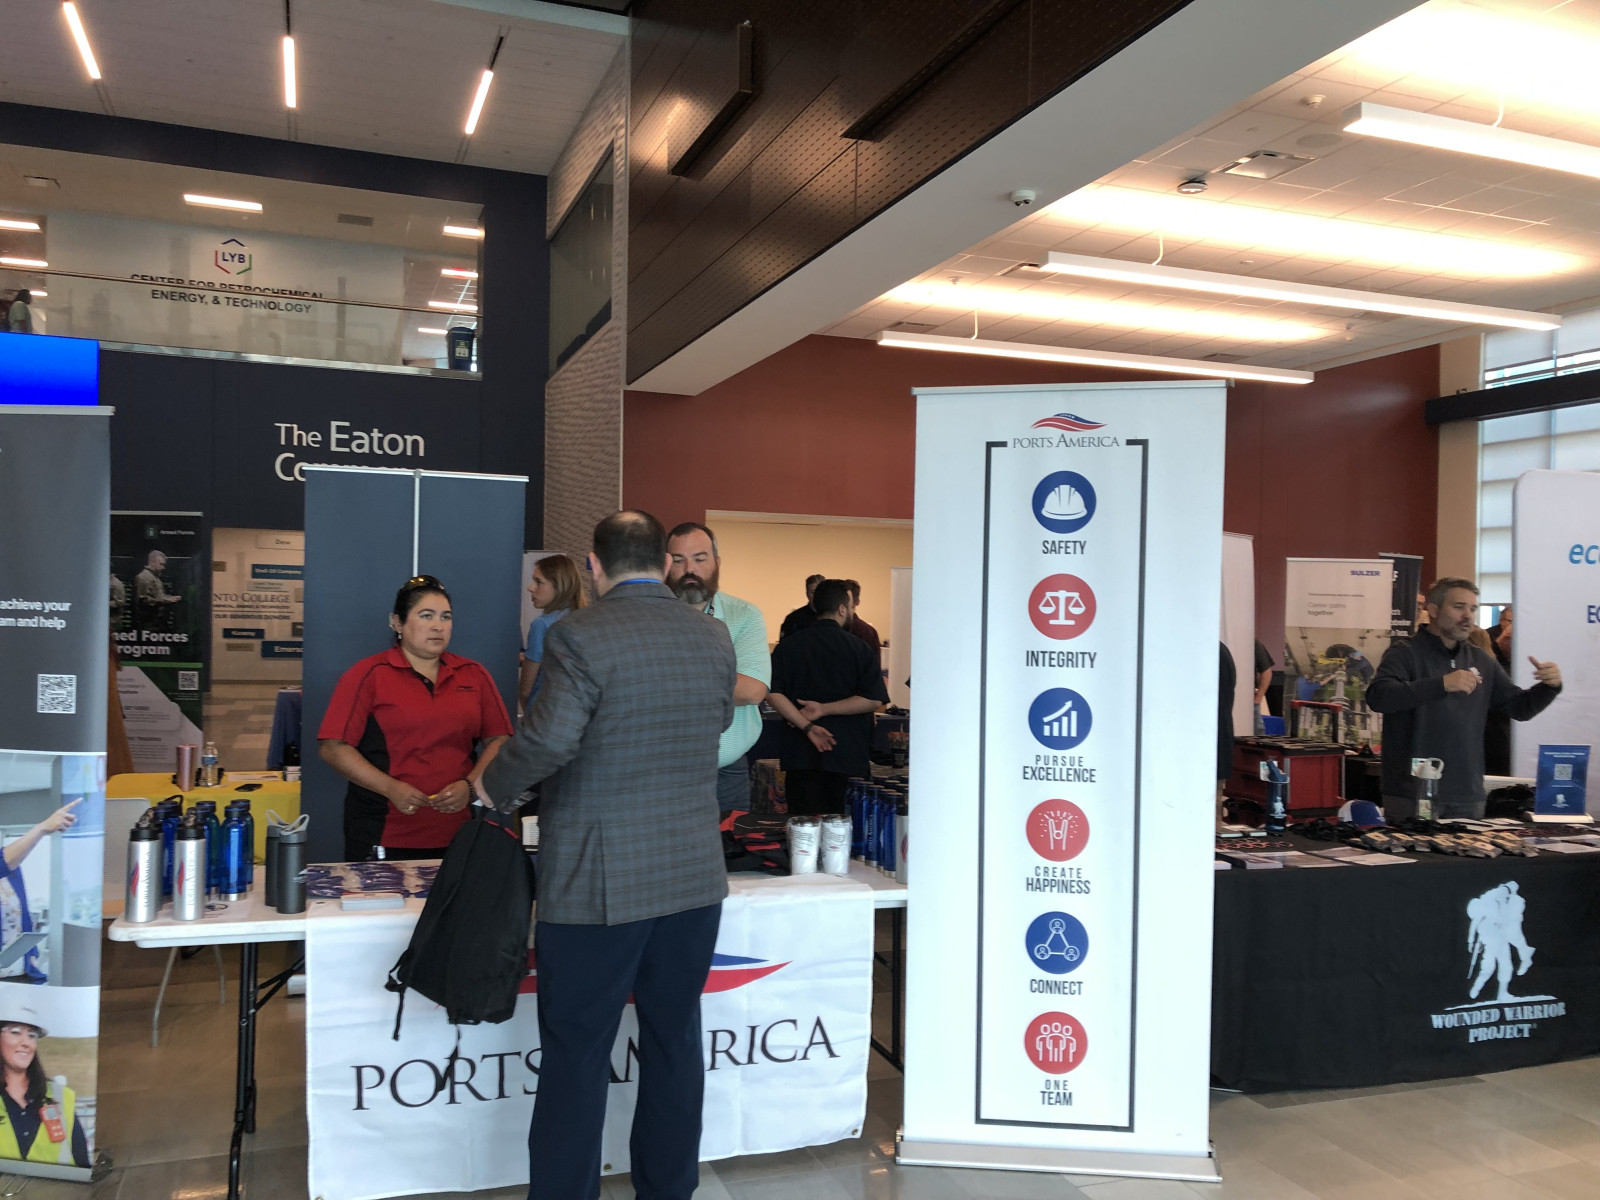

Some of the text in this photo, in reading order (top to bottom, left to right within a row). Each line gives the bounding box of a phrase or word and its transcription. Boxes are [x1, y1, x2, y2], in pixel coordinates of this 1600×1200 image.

[221, 251, 246, 263] LYB
[151, 289, 312, 314] ENERGY, & TECHNOLOGY
[274, 420, 425, 457] The Eaton
[1012, 433, 1120, 449] PORTS AMERICA
[1041, 540, 1087, 555] SAFETY
[1350, 569, 1381, 577] SULZER
[241, 592, 292, 603] COLLEGE
[43, 601, 72, 613] your
[17, 615, 39, 627] and
[39, 615, 67, 631] help
[141, 630, 189, 643] Forces
[117, 645, 170, 658] rogram
[1025, 650, 1098, 669] INTEGRITY
[1035, 755, 1084, 767] PURSUE
[1022, 766, 1097, 783] EXCELLENCE
[1034, 866, 1083, 879] CREATE
[1026, 877, 1091, 895] HAPPINESS
[1029, 979, 1084, 995] CONNECT
[1430, 1001, 1567, 1029] WOUNDED WARRIOR
[350, 1048, 543, 1111] PORTS
[1044, 1079, 1069, 1091] ONE
[1040, 1090, 1073, 1106] TEAM
